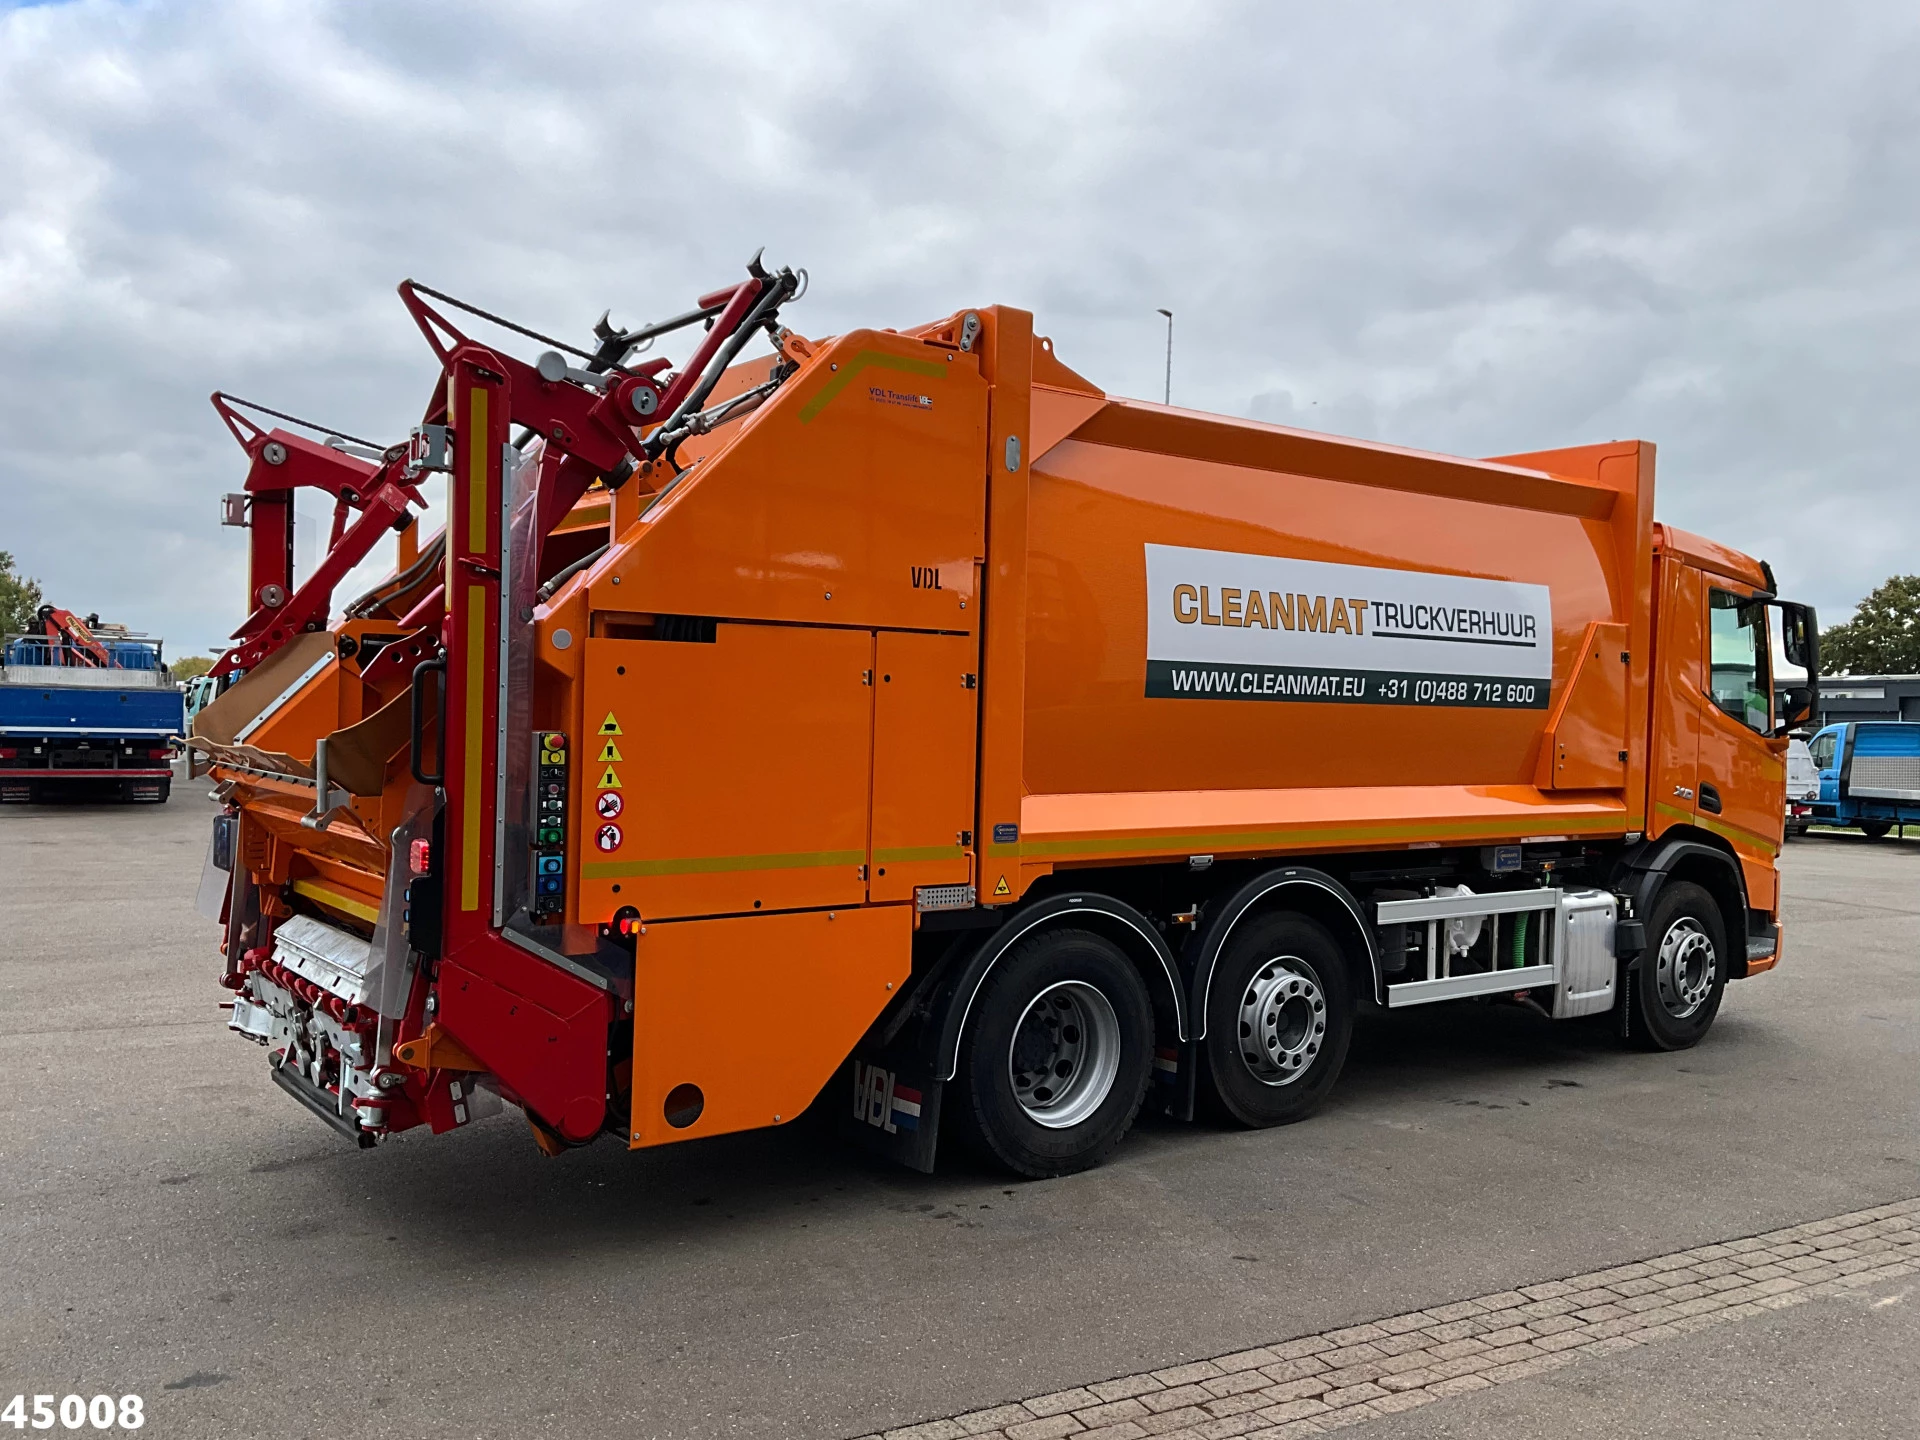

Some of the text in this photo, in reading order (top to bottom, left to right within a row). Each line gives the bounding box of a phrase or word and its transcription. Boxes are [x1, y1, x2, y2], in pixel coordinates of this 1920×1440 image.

[869, 387, 886, 397] VDL
[888, 390, 918, 402] Translift
[911, 566, 942, 590] VDL
[1172, 584, 1536, 638] CLEANMAT TRUCKVERHUUR
[1171, 669, 1535, 703] WWW.CLEANMAT.EU +31 (0)488 712 600
[853, 1059, 897, 1135] VDL
